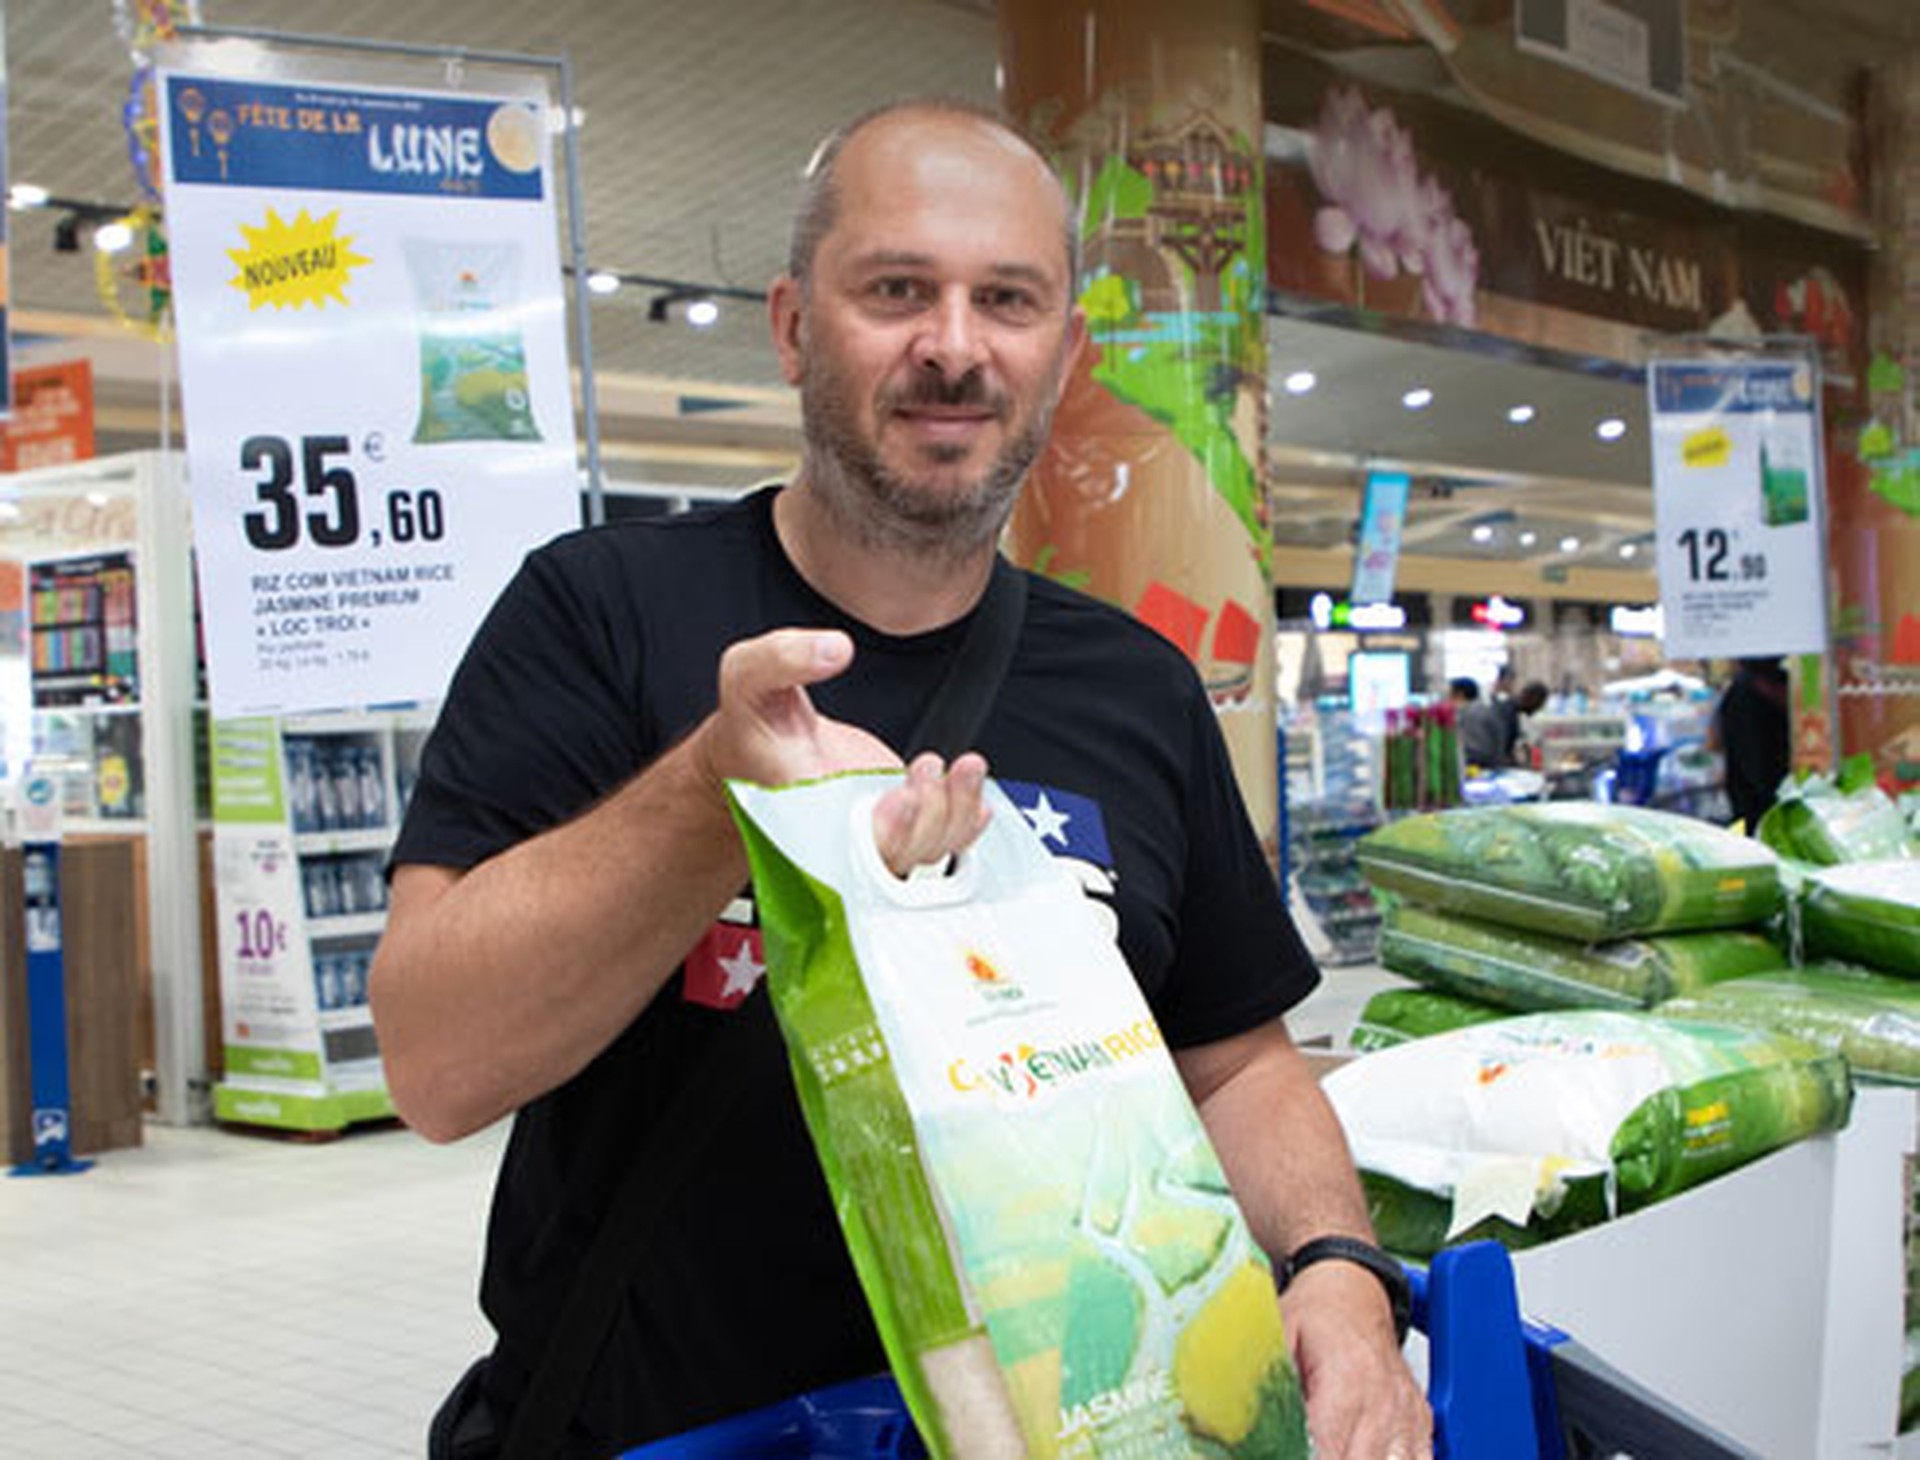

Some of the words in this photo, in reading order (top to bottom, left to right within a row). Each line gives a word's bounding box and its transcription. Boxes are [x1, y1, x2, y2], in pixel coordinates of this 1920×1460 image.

[237, 99, 291, 131] FÊTE
[298, 108, 329, 133] DE
[367, 123, 484, 177] LUNE
[245, 243, 336, 290] NOUVEAU
[1627, 248, 1701, 313] NAM
[240, 434, 360, 551] 35
[252, 575, 280, 592] RIZ
[285, 572, 327, 590] COM
[332, 566, 409, 587] VIETNAM
[414, 564, 455, 582] RICE
[254, 595, 331, 615] JASMINE
[338, 589, 419, 609] PREMIUM
[270, 618, 309, 636] LOC
